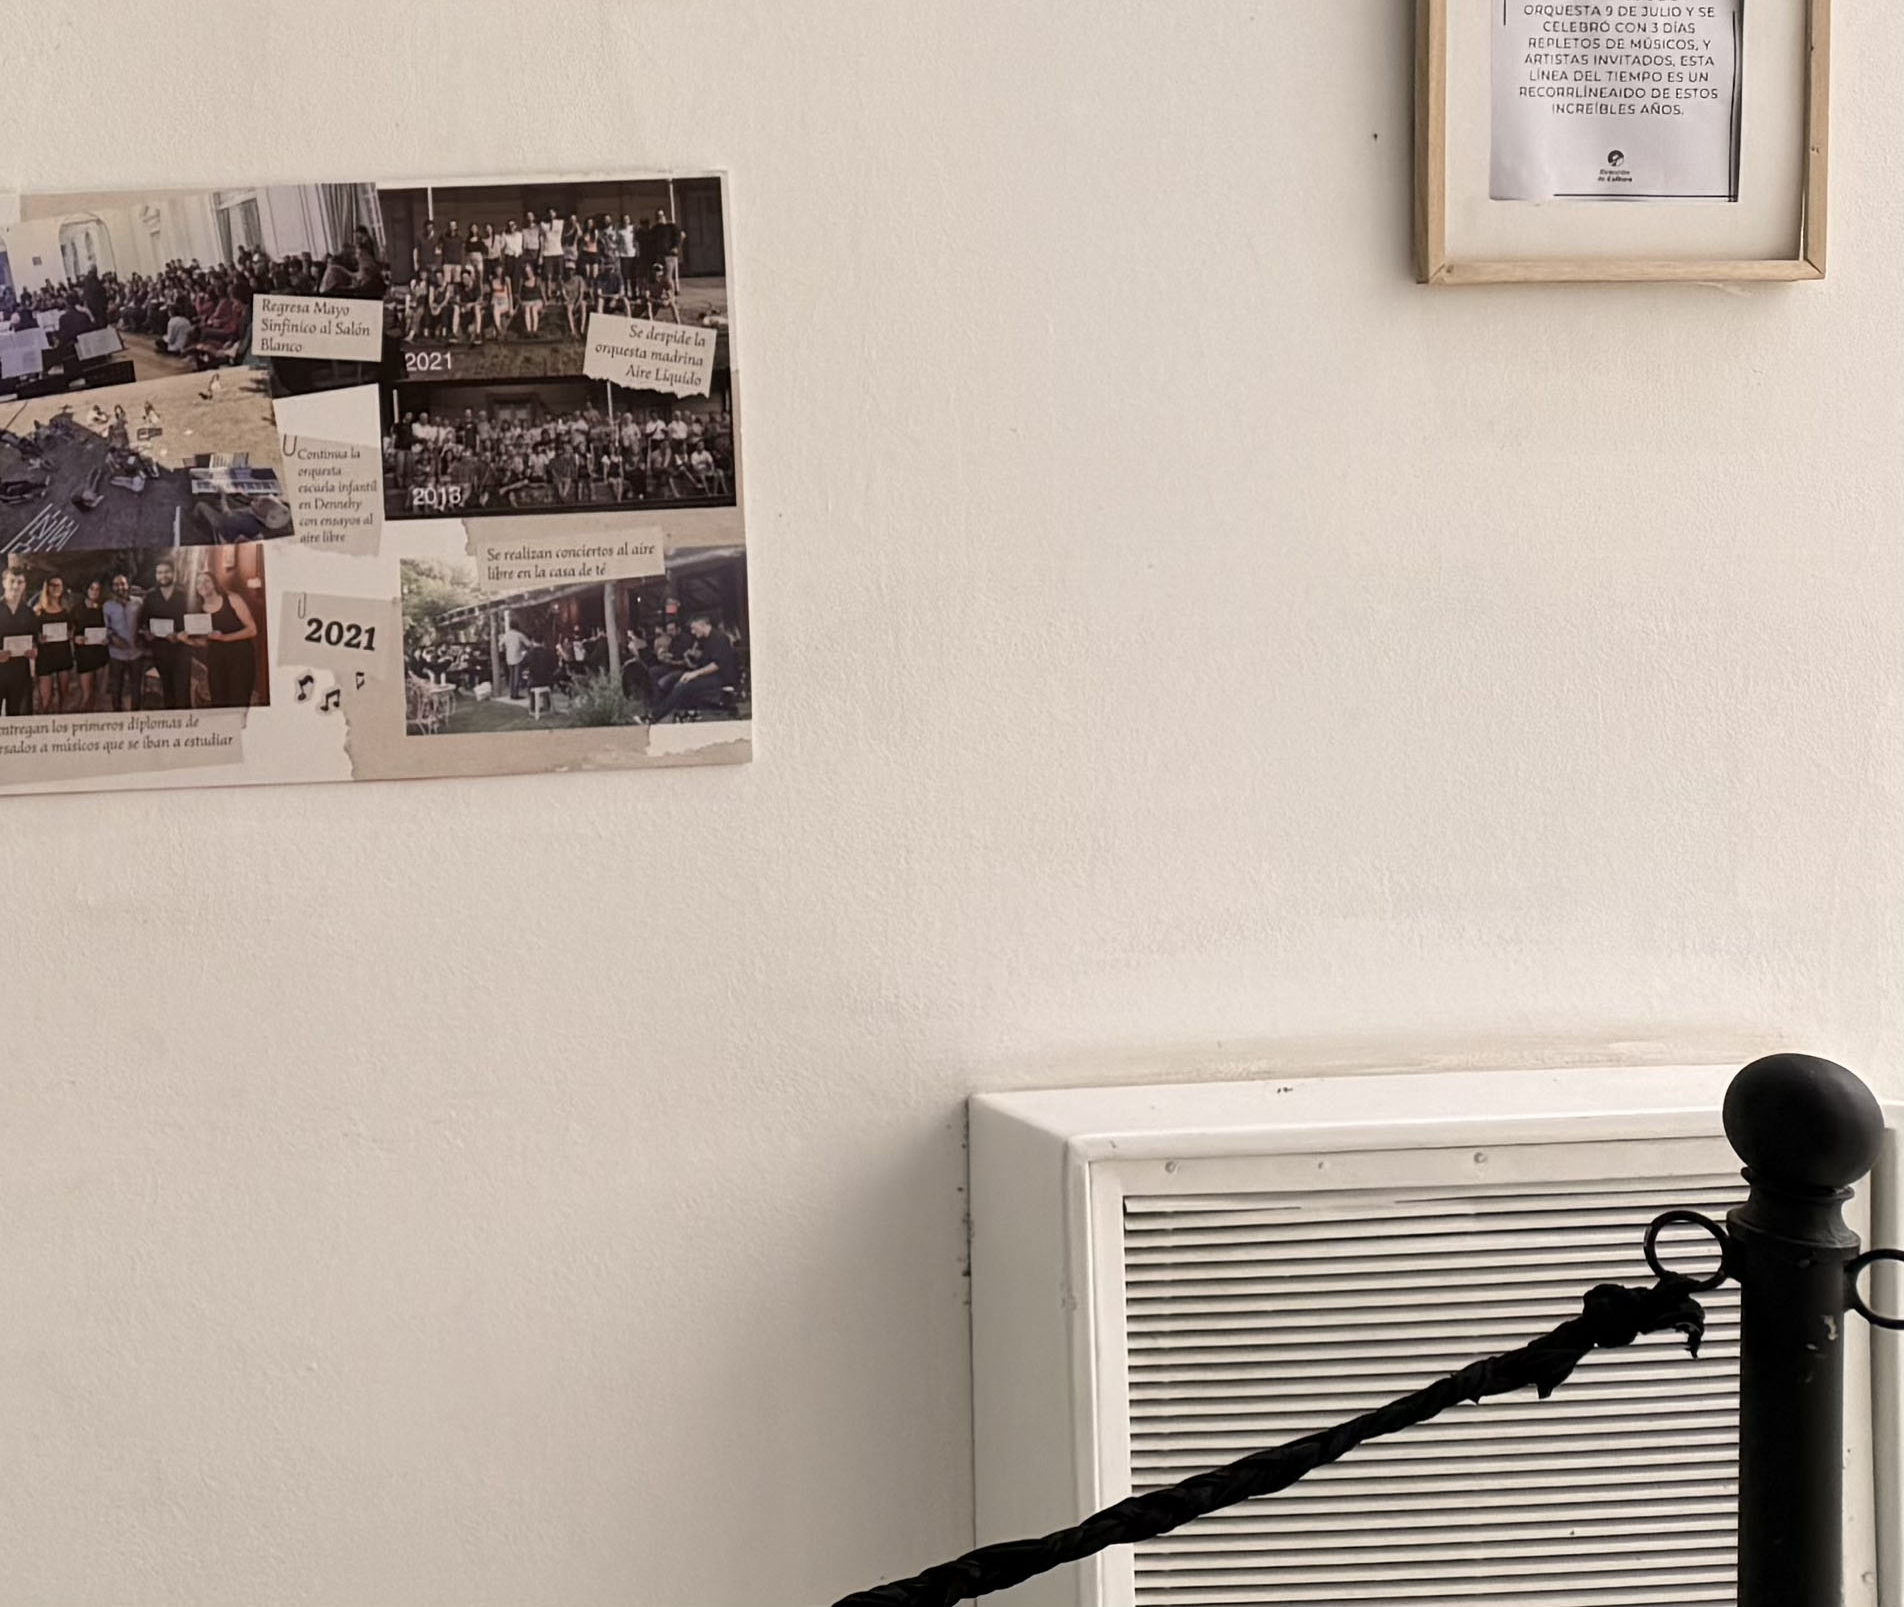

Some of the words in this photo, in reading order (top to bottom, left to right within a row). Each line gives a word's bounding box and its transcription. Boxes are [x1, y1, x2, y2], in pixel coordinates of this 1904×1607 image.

[261, 297, 310, 316] Regresa
[313, 301, 350, 320] Mayo
[319, 319, 332, 335] al
[335, 320, 370, 337] Salón
[260, 337, 303, 353] Blanco
[404, 351, 452, 372] 2021
[304, 617, 376, 652] 2021
